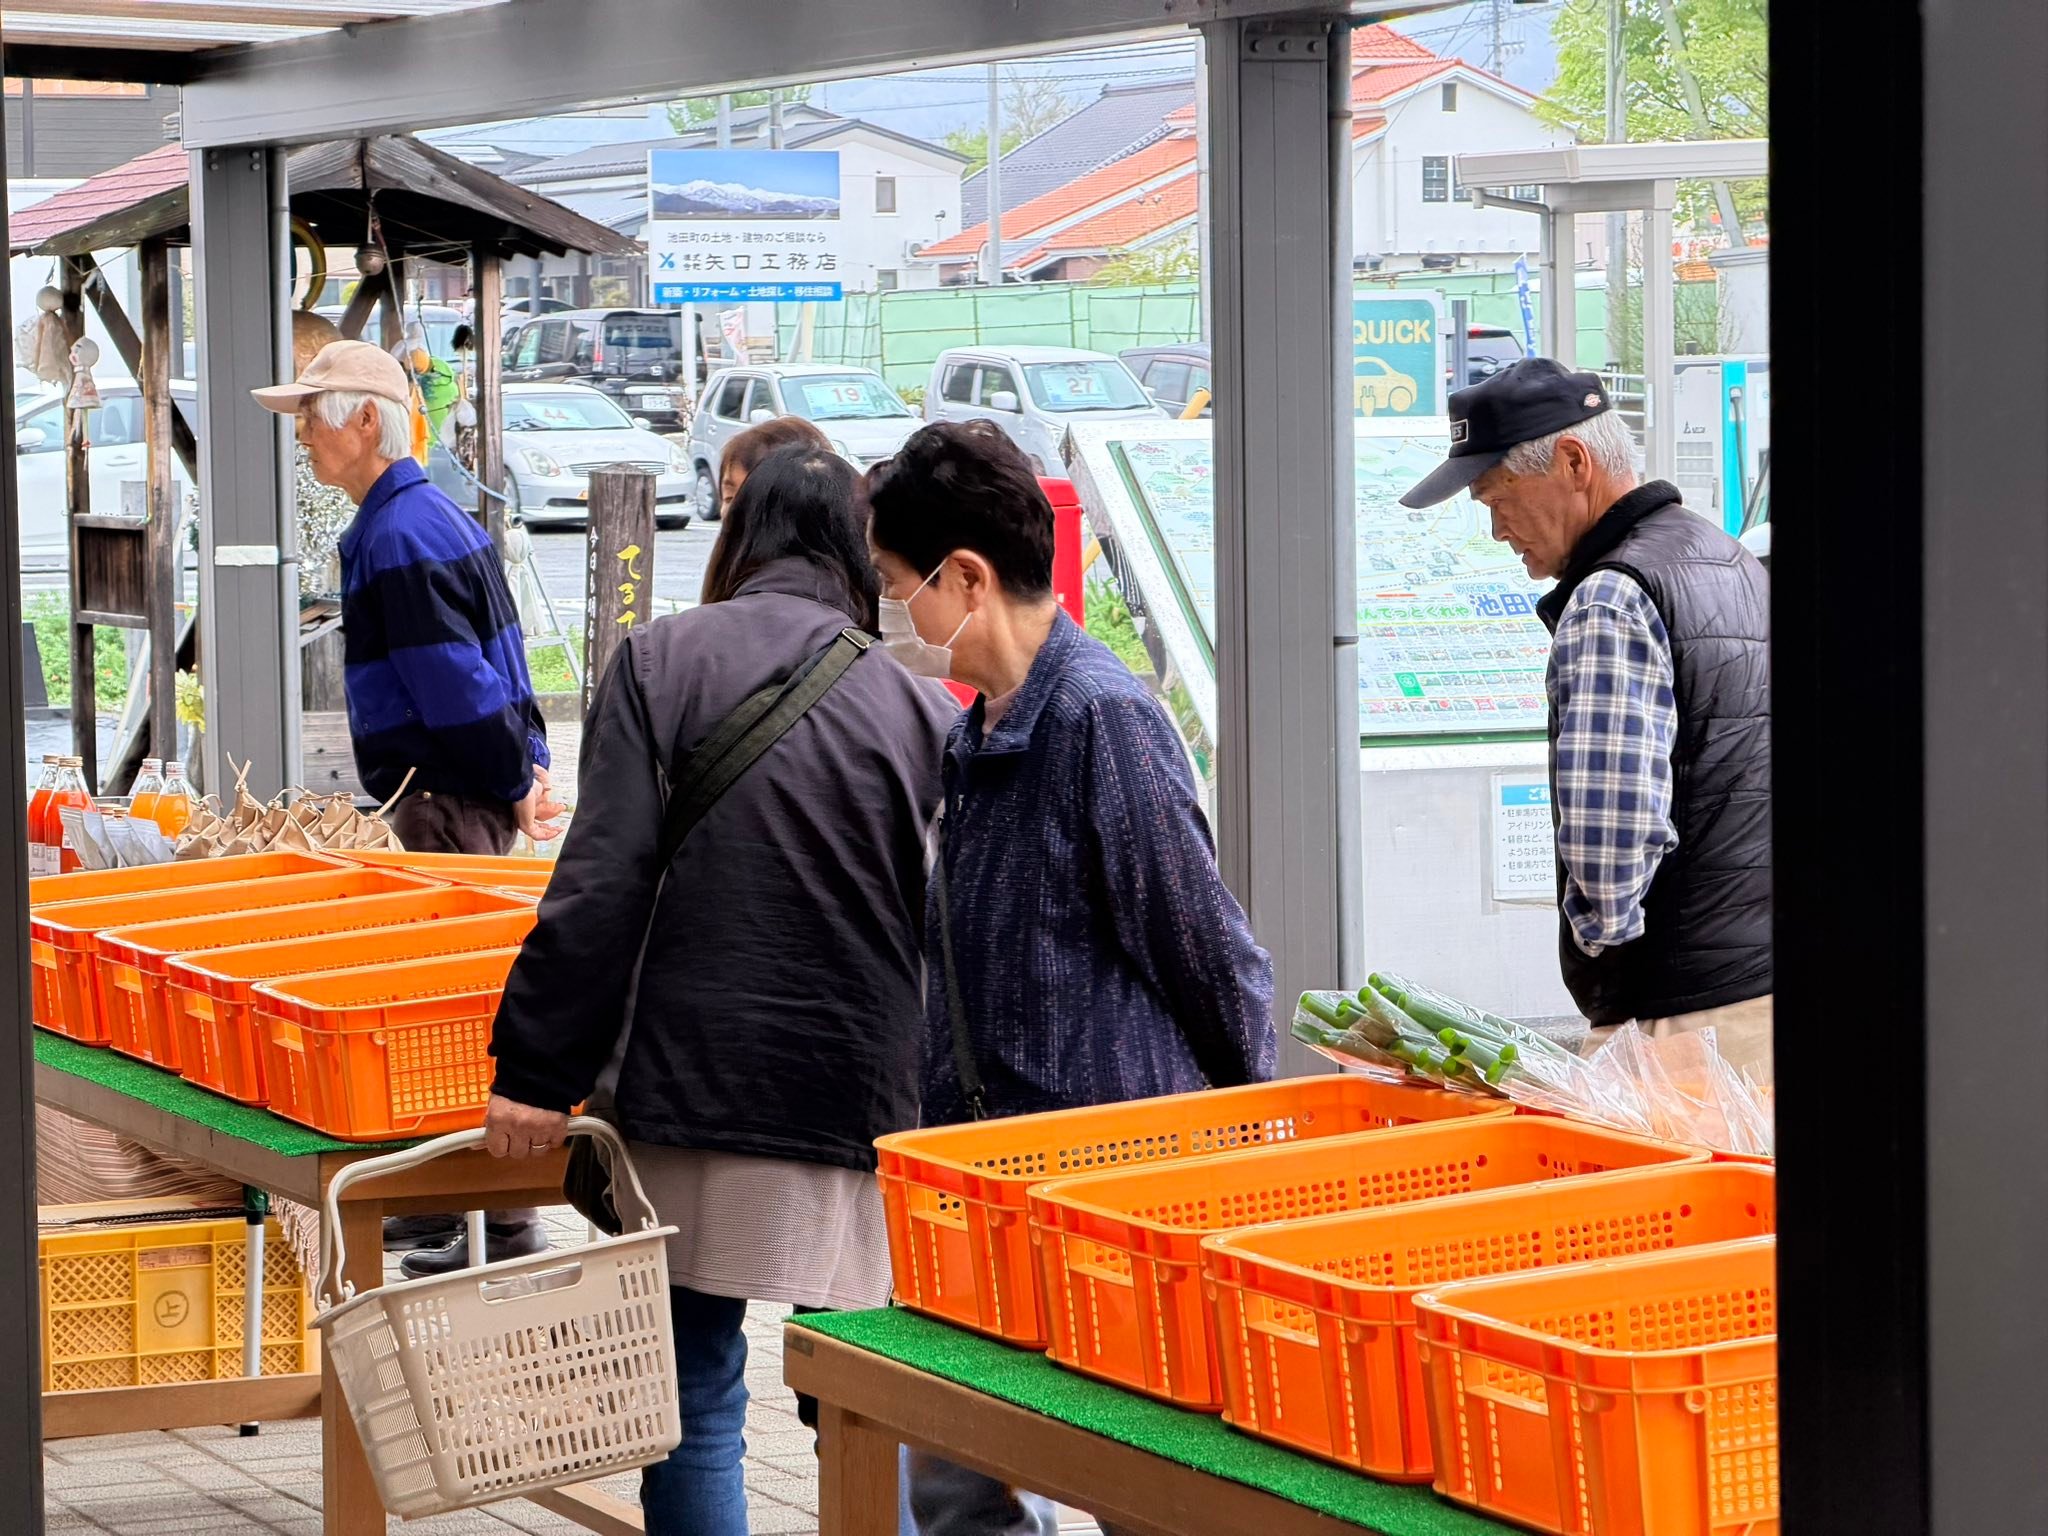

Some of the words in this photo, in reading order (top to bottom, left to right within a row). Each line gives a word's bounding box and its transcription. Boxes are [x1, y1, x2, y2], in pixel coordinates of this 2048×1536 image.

[705, 252, 838, 271] 矢口工務店
[1067, 376, 1093, 394] 27
[833, 387, 860, 402] 19
